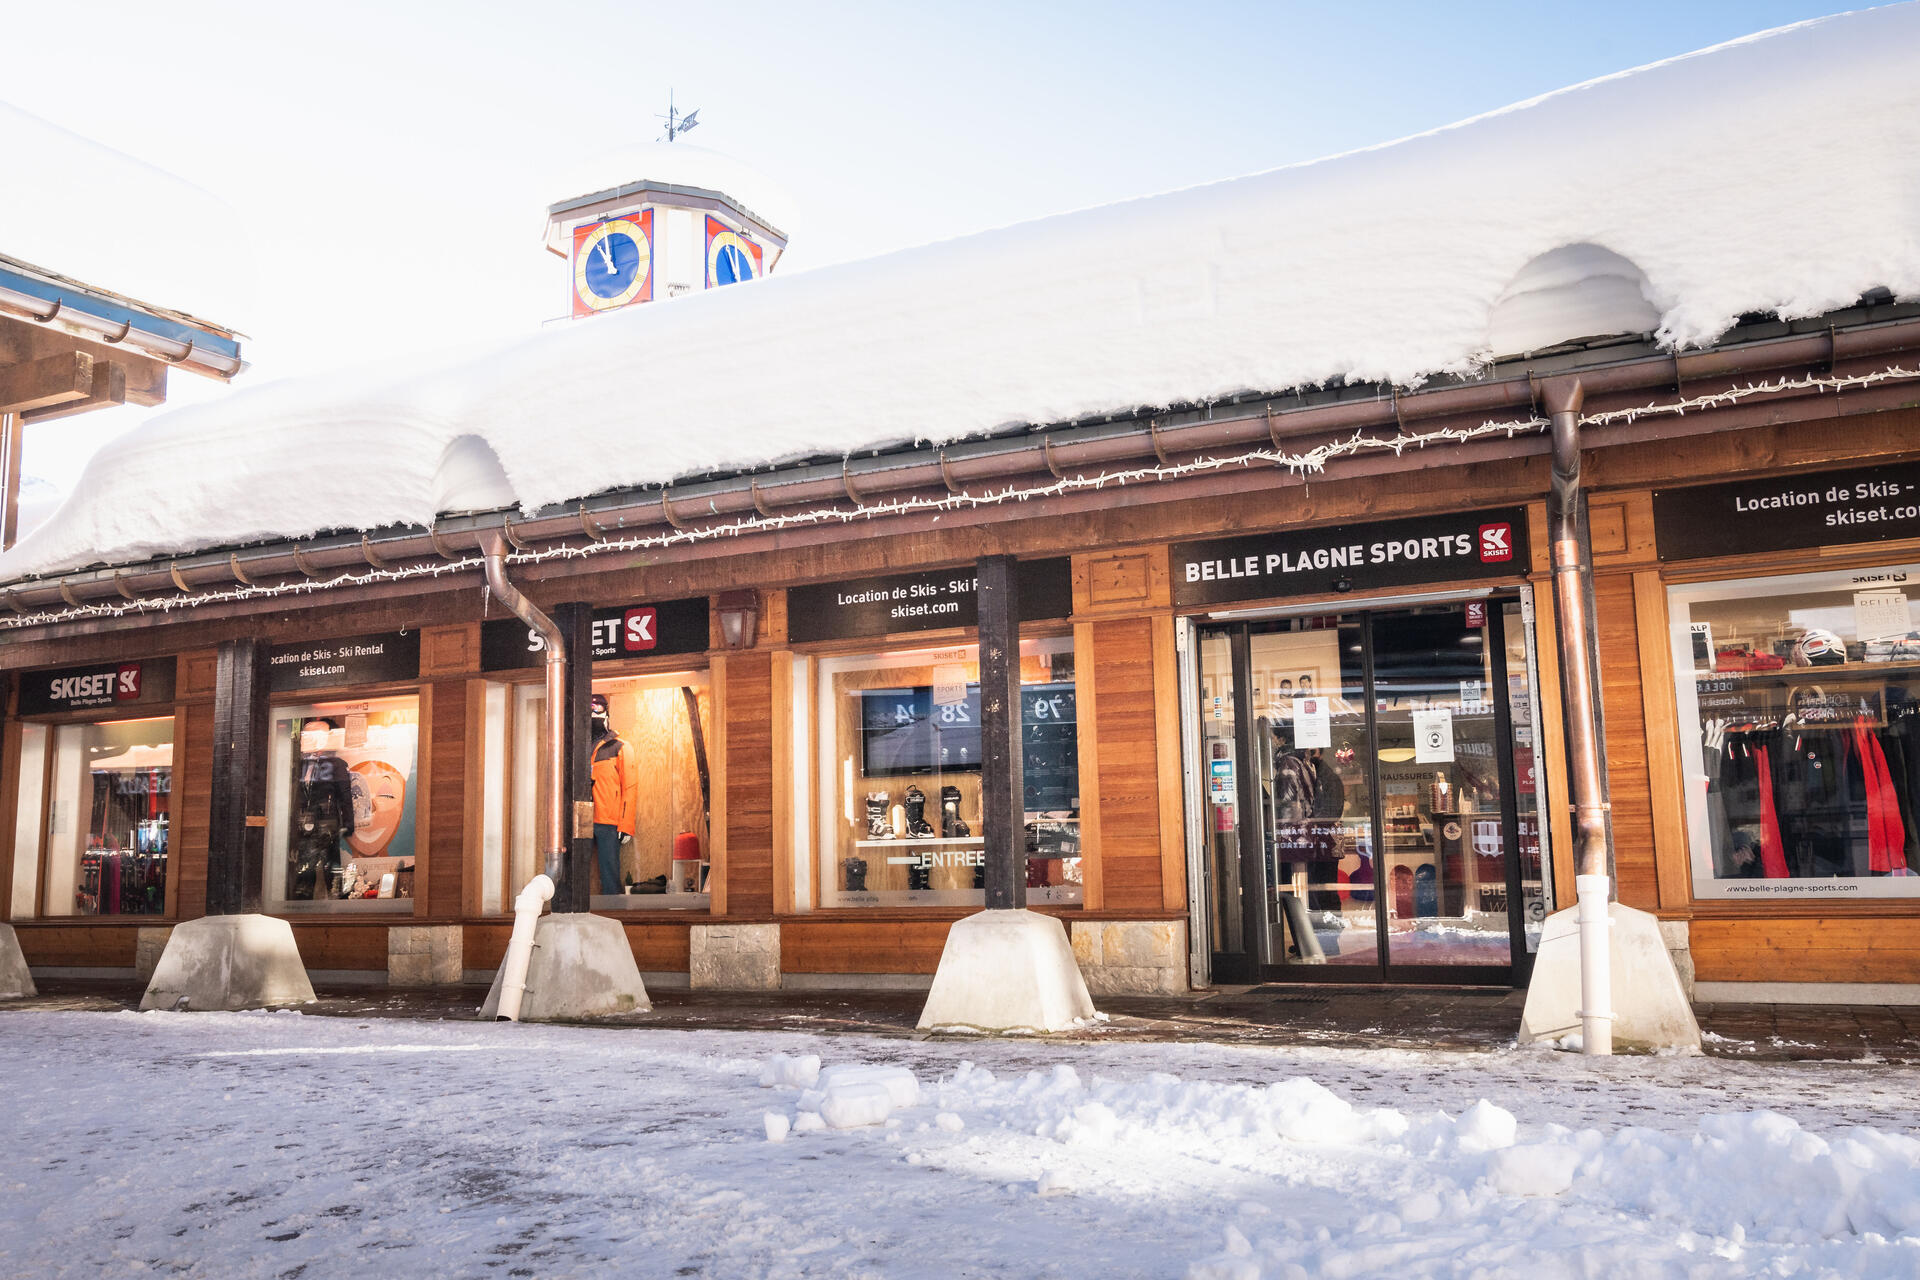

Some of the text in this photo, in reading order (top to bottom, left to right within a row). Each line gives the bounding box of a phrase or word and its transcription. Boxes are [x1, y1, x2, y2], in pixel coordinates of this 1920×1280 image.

[1736, 491, 1820, 512] Location
[1825, 487, 1850, 502] de
[1855, 481, 1900, 499] Skis
[1185, 534, 1472, 583] BELLE PLAGNE SPORTS
[1483, 548, 1510, 557] SKISET
[838, 589, 889, 605] Location
[892, 587, 907, 600] de
[910, 583, 937, 597] Skis
[949, 579, 969, 593] Ski
[891, 602, 959, 618] skiset.com
[301, 651, 312, 661] de
[313, 649, 332, 660] Skis
[339, 646, 353, 658] Ski
[355, 643, 384, 656] Rental
[595, 647, 617, 656] Sports
[50, 673, 117, 700] SKISET
[1381, 772, 1434, 781] HAUSSURES
[922, 850, 984, 868] ENTREE
[1725, 884, 1858, 894] www.belle-plagne-sports.com
